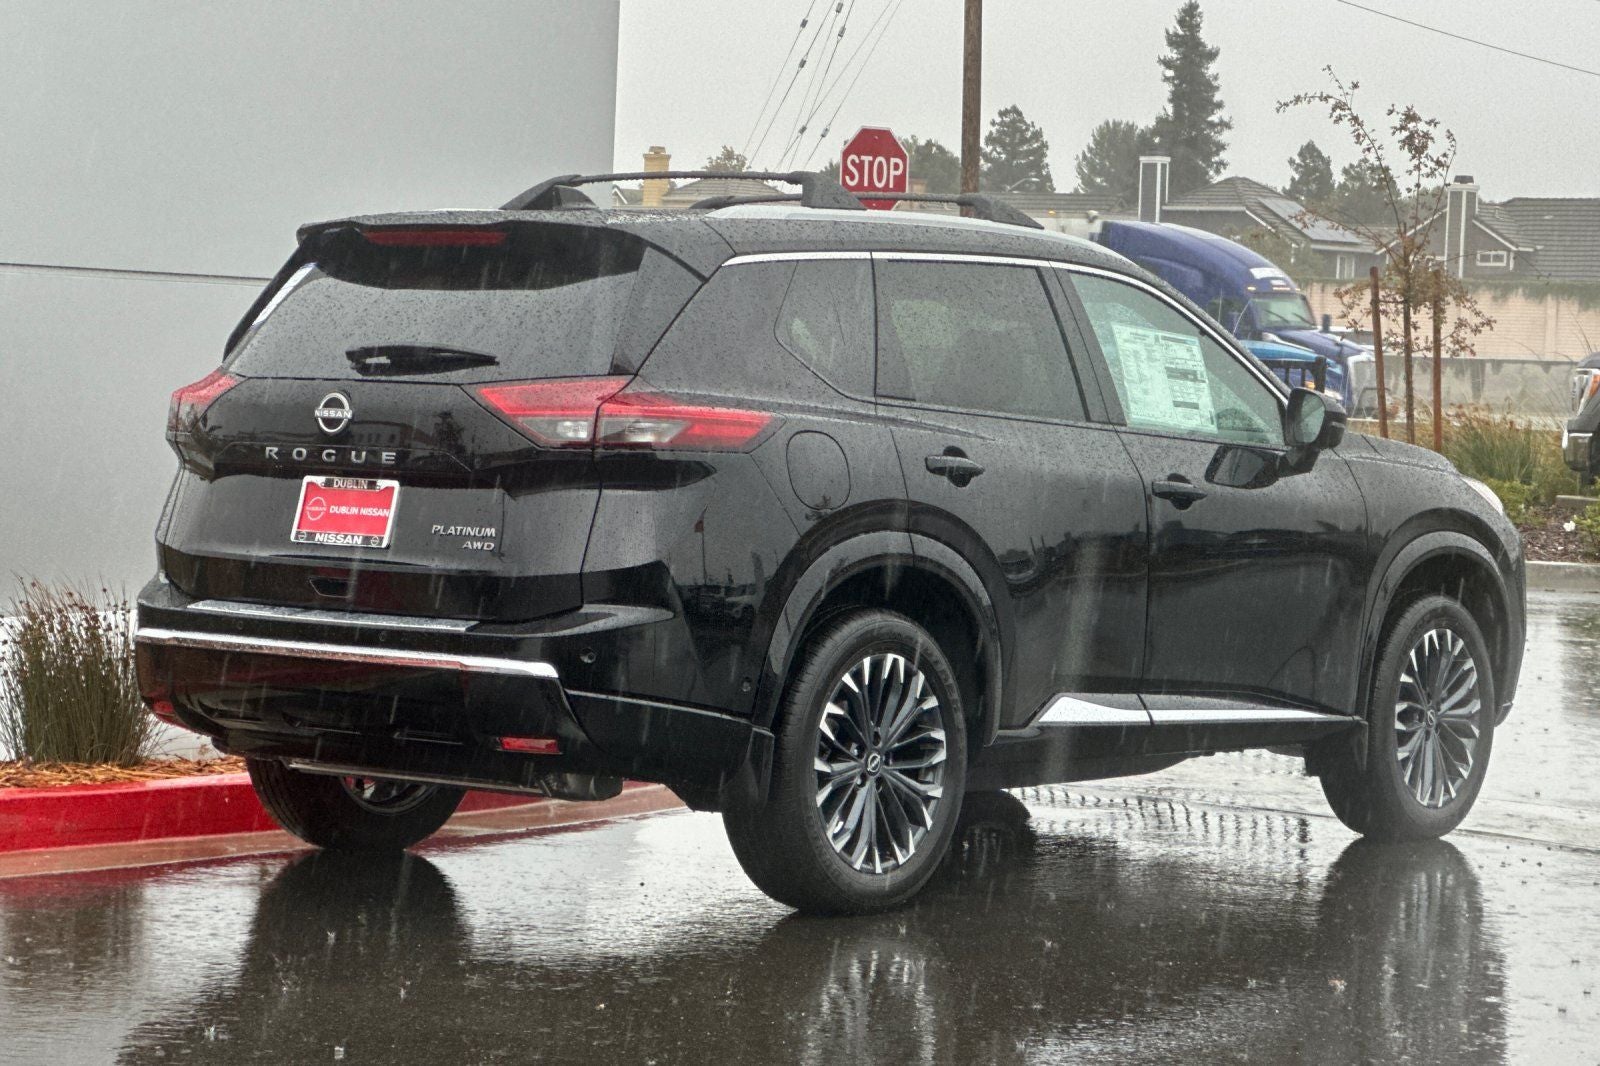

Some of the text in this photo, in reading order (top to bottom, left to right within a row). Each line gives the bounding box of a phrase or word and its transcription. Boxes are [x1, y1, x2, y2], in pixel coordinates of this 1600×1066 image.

[845, 154, 903, 188] STOP
[315, 409, 352, 418] NISSAN
[265, 446, 396, 465] ROGUE
[333, 478, 368, 490] DUBLIN
[329, 506, 390, 517] DUBLIN NISSAN
[431, 524, 496, 537] PLATINUM
[314, 532, 363, 545] NISSAN
[462, 540, 495, 551] AWD
